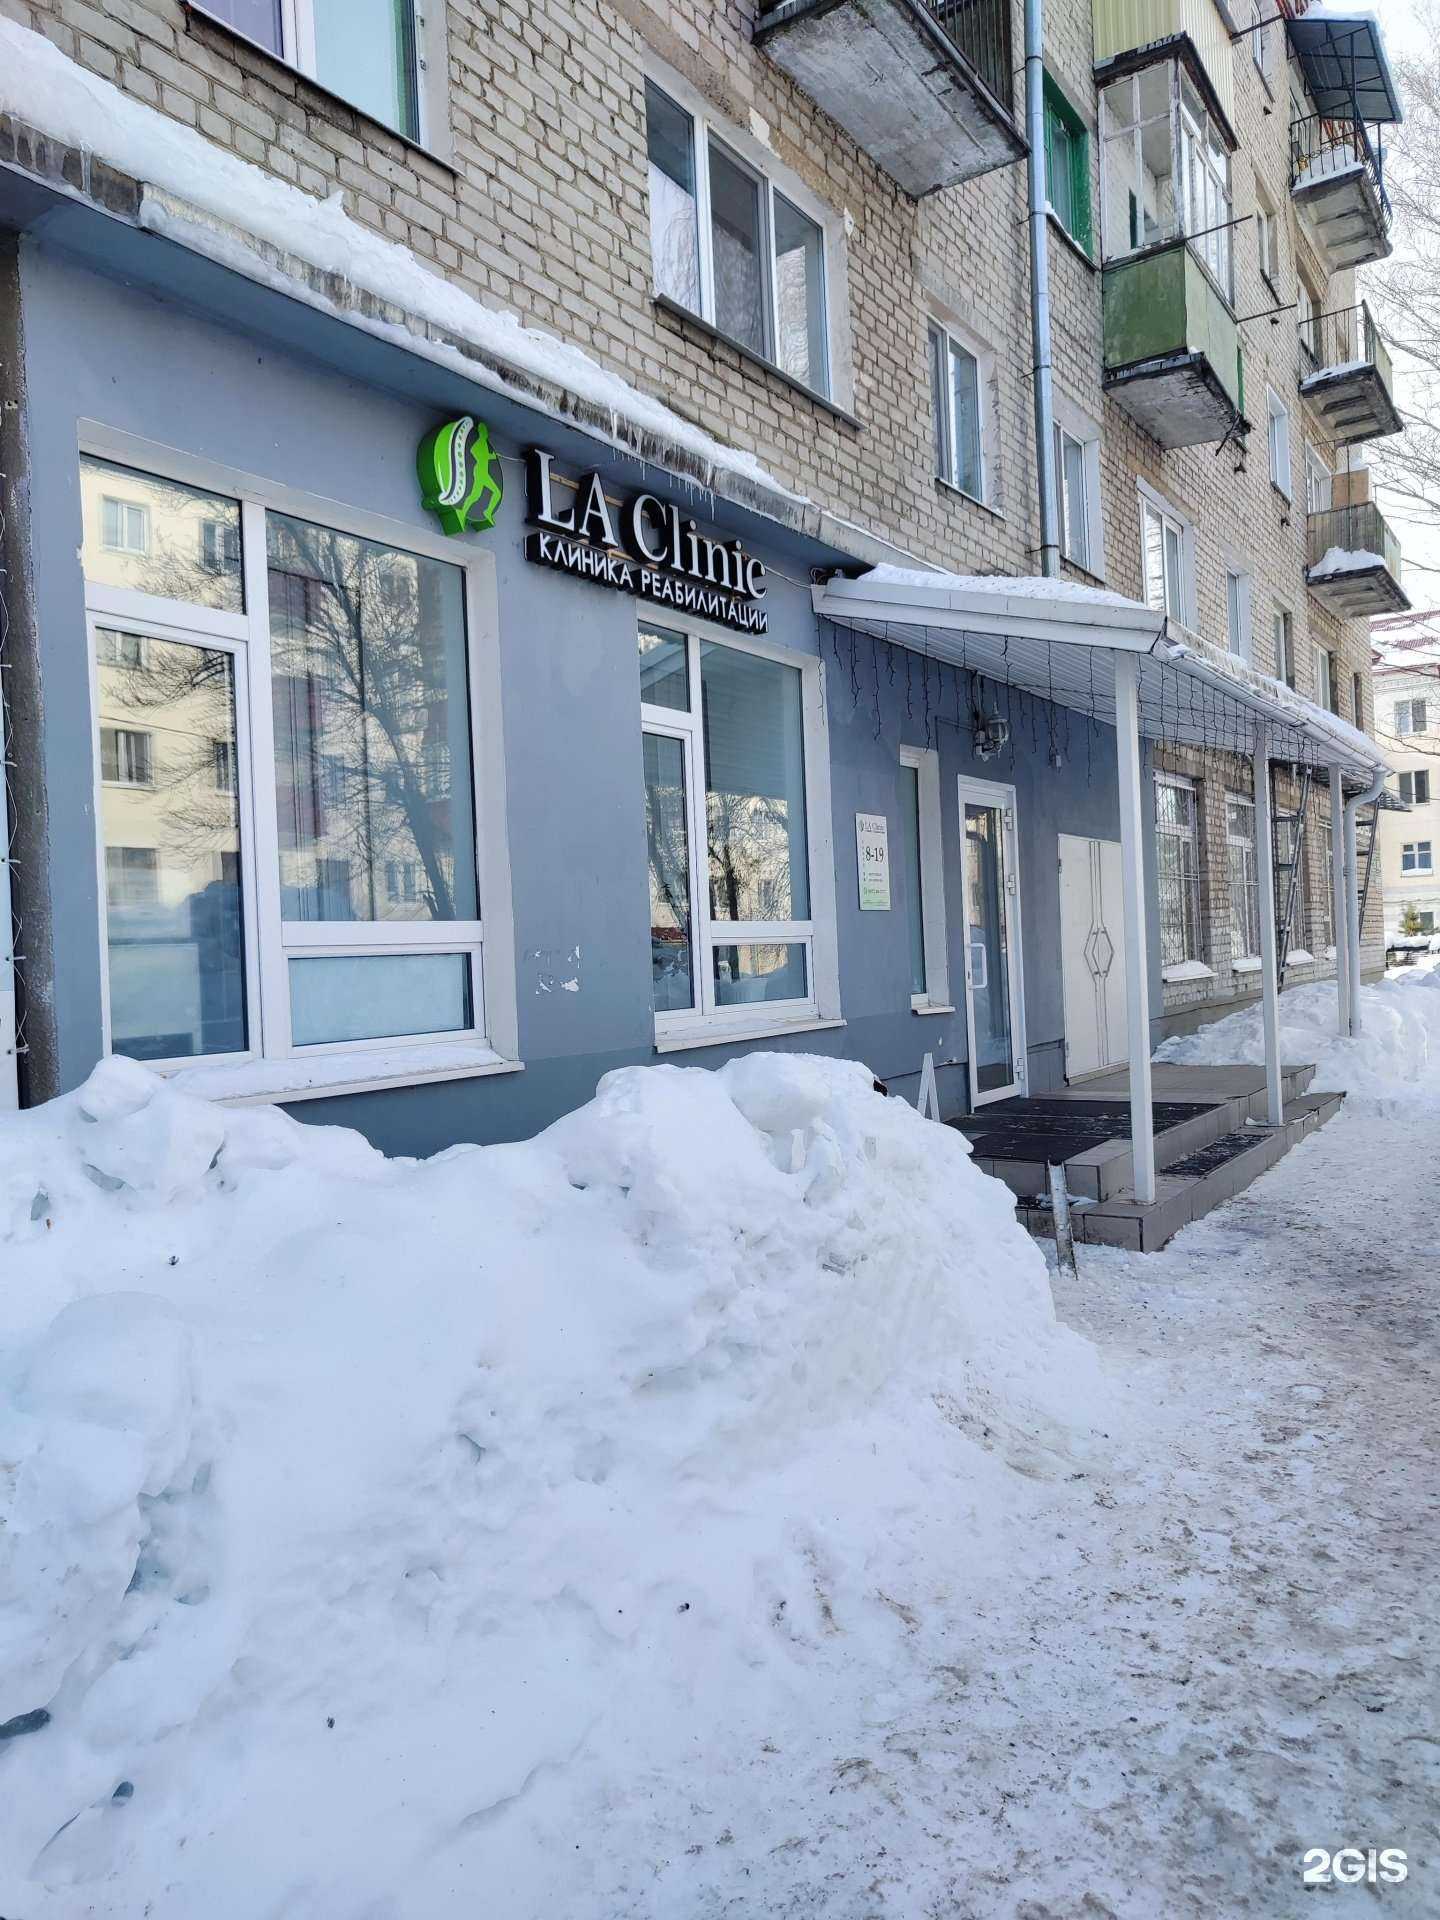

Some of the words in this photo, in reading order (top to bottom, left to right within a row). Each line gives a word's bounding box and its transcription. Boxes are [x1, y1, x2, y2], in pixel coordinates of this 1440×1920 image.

[534, 448, 619, 547] LA
[632, 494, 768, 599] Clinic
[539, 532, 634, 588] КЛИНИКА
[641, 569, 768, 632] РЕАБИЛИТАЦИИ
